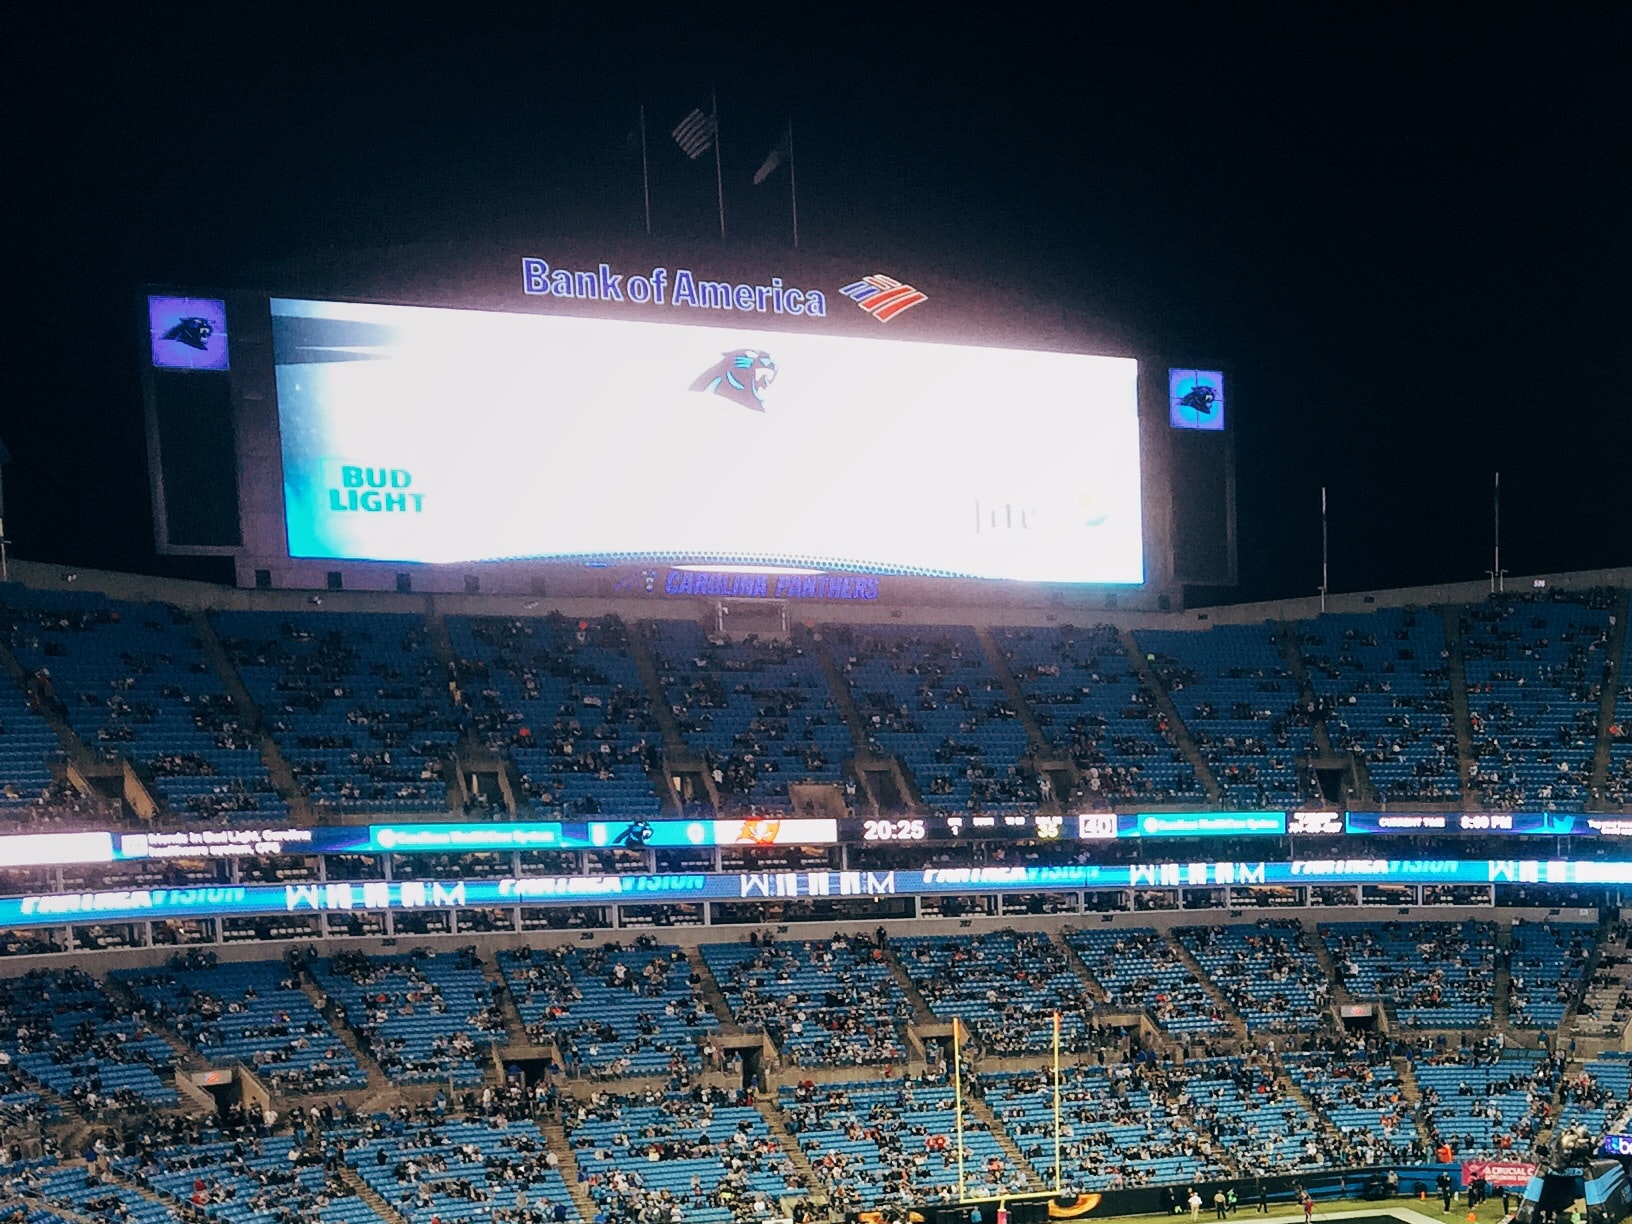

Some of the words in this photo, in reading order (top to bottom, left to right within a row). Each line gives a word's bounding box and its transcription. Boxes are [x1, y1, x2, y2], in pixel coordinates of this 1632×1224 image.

[522, 257, 624, 302] Bank
[626, 267, 668, 305] of
[671, 270, 827, 318] America
[341, 465, 412, 488] BUD
[329, 489, 426, 513] LIGHT
[664, 570, 769, 597] CAROLINA
[775, 574, 880, 600] PANTHERS
[863, 820, 925, 840] 20:25
